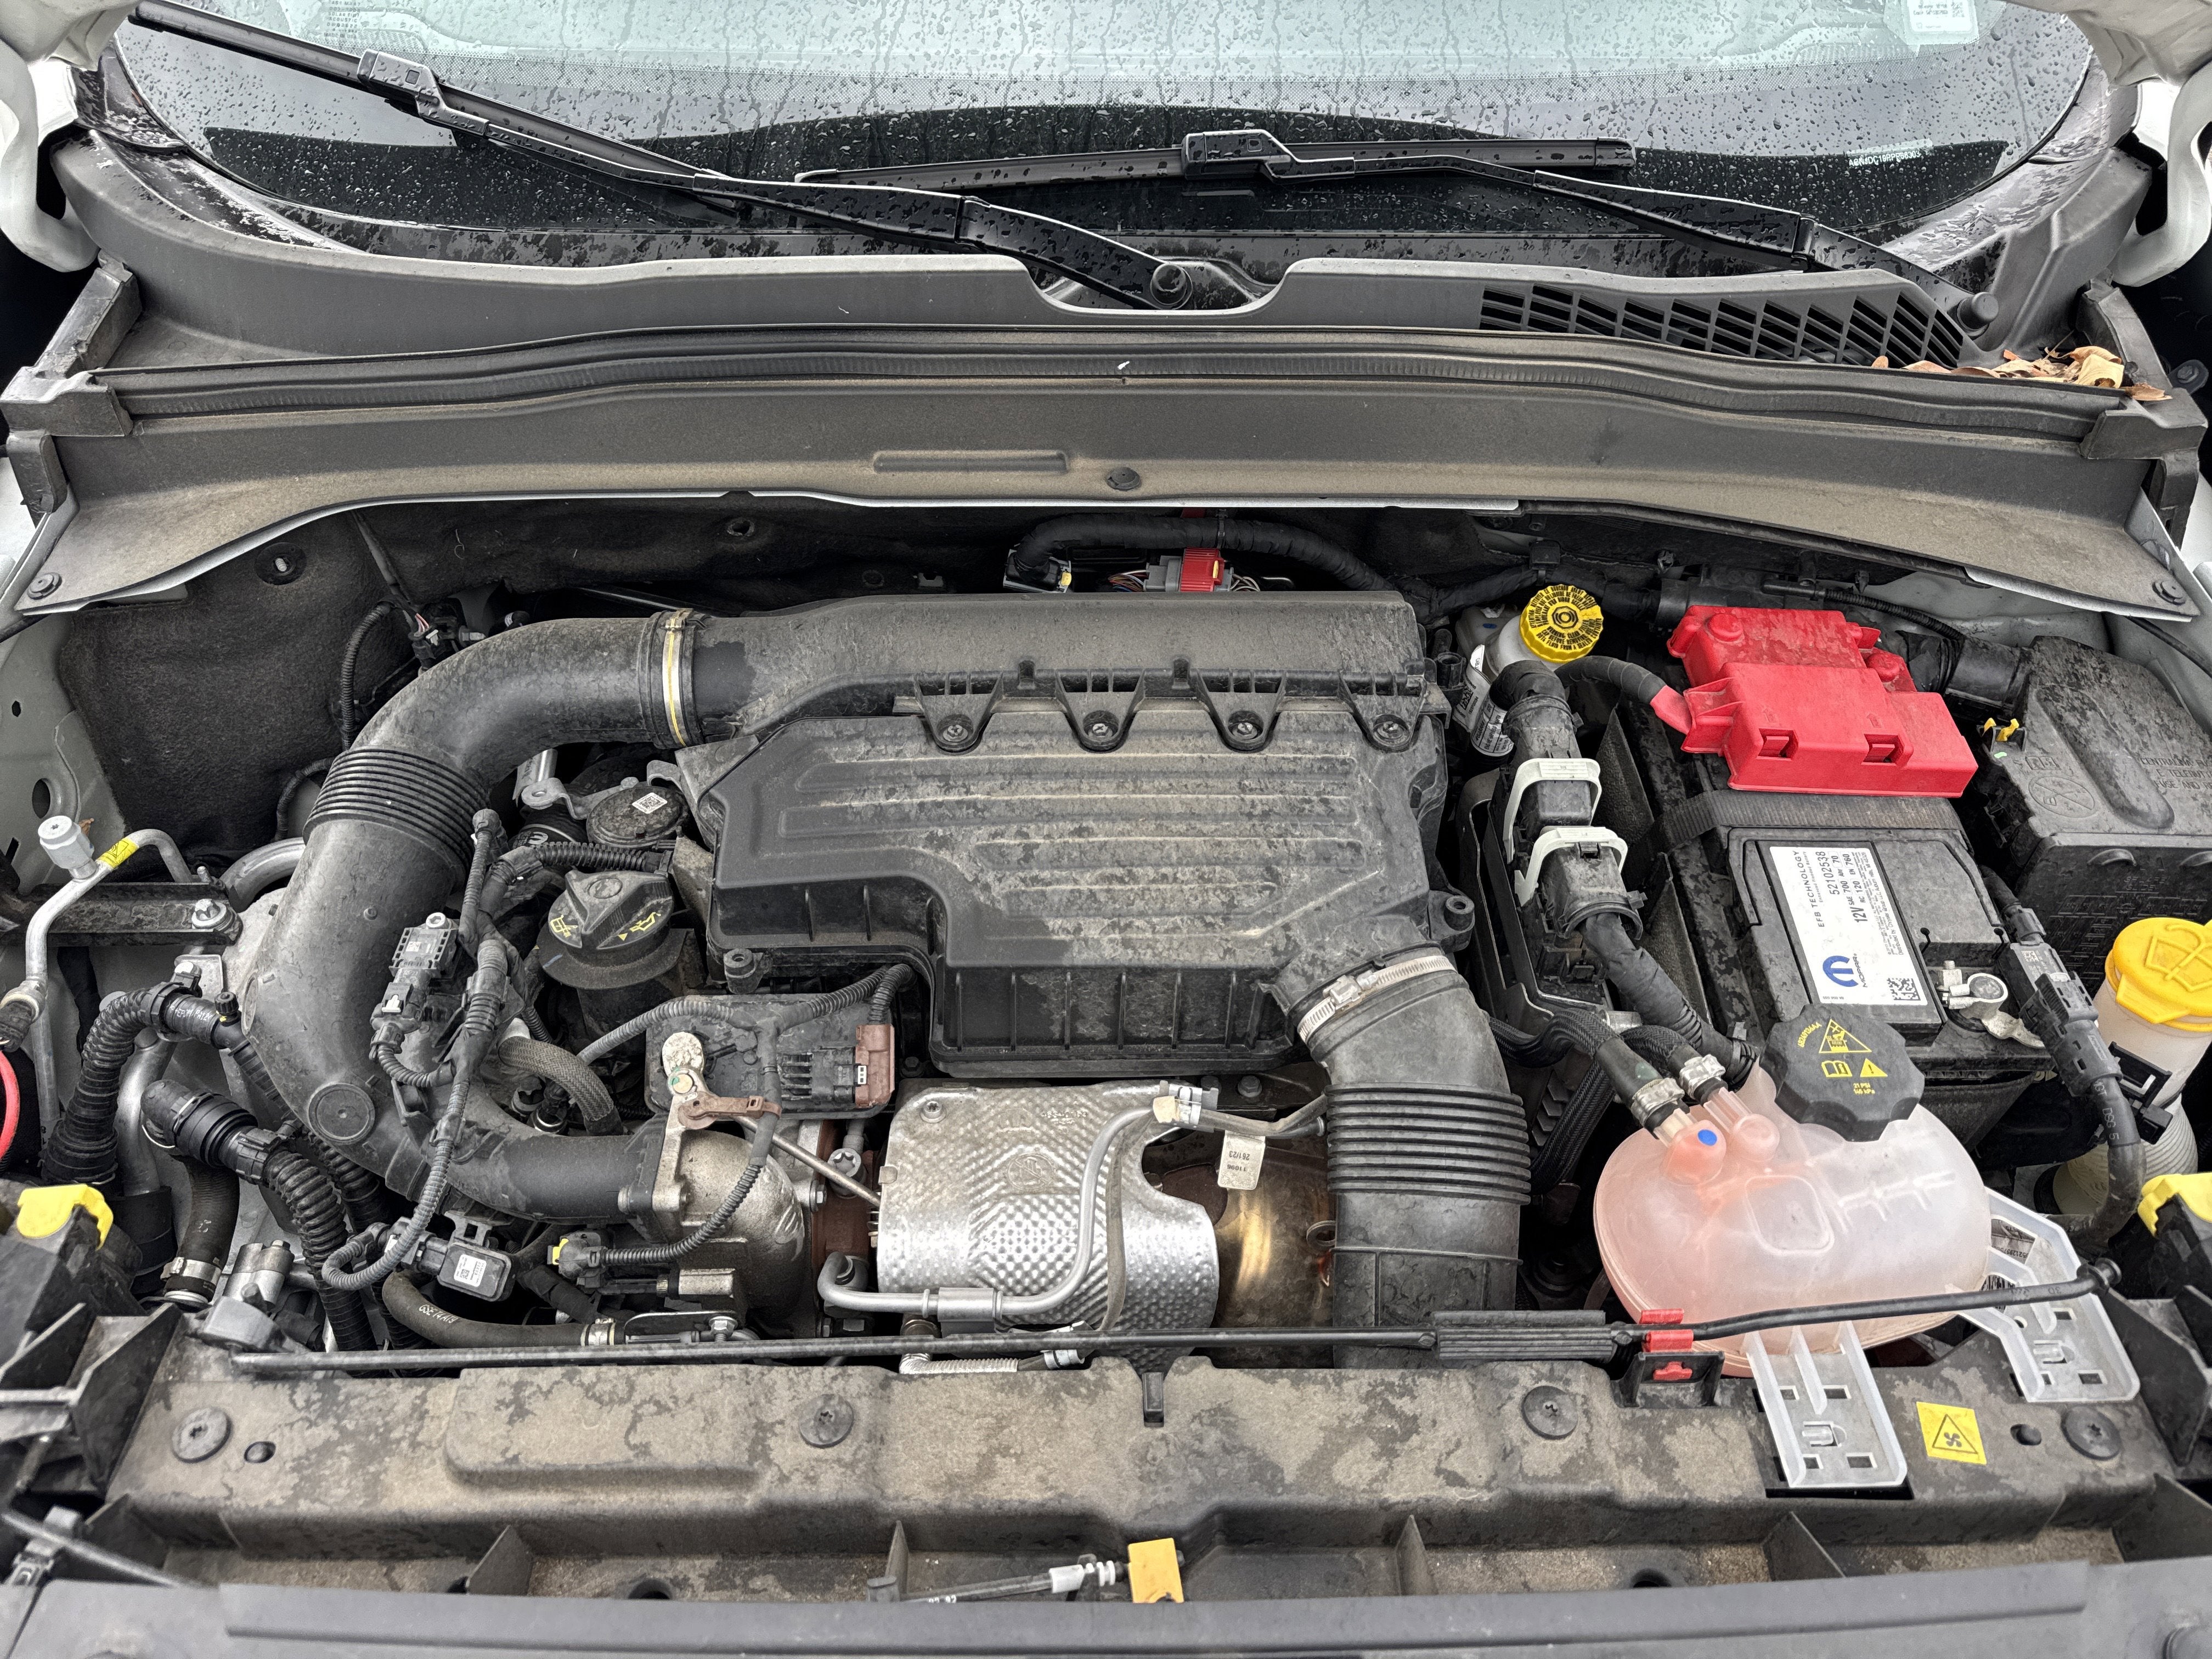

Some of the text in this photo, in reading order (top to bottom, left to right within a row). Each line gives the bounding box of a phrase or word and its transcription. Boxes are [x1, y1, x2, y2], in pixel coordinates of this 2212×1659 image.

[1546, 640, 1559, 648] FLUID
[1577, 637, 1592, 648] SEALED
[1548, 635, 1565, 644] BEFORE
[2153, 780, 2179, 789] FUSE
[2182, 781, 2200, 789] AND
[1843, 854, 1853, 865] 760
[1816, 851, 1839, 894] 52102538
[1793, 851, 1824, 927] EFB TECHNOLOGY
[1840, 881, 1850, 893] 700
[1853, 881, 1863, 893] 120
[1850, 907, 1867, 922] 12V
[1229, 1150, 1250, 1161] 261/23
